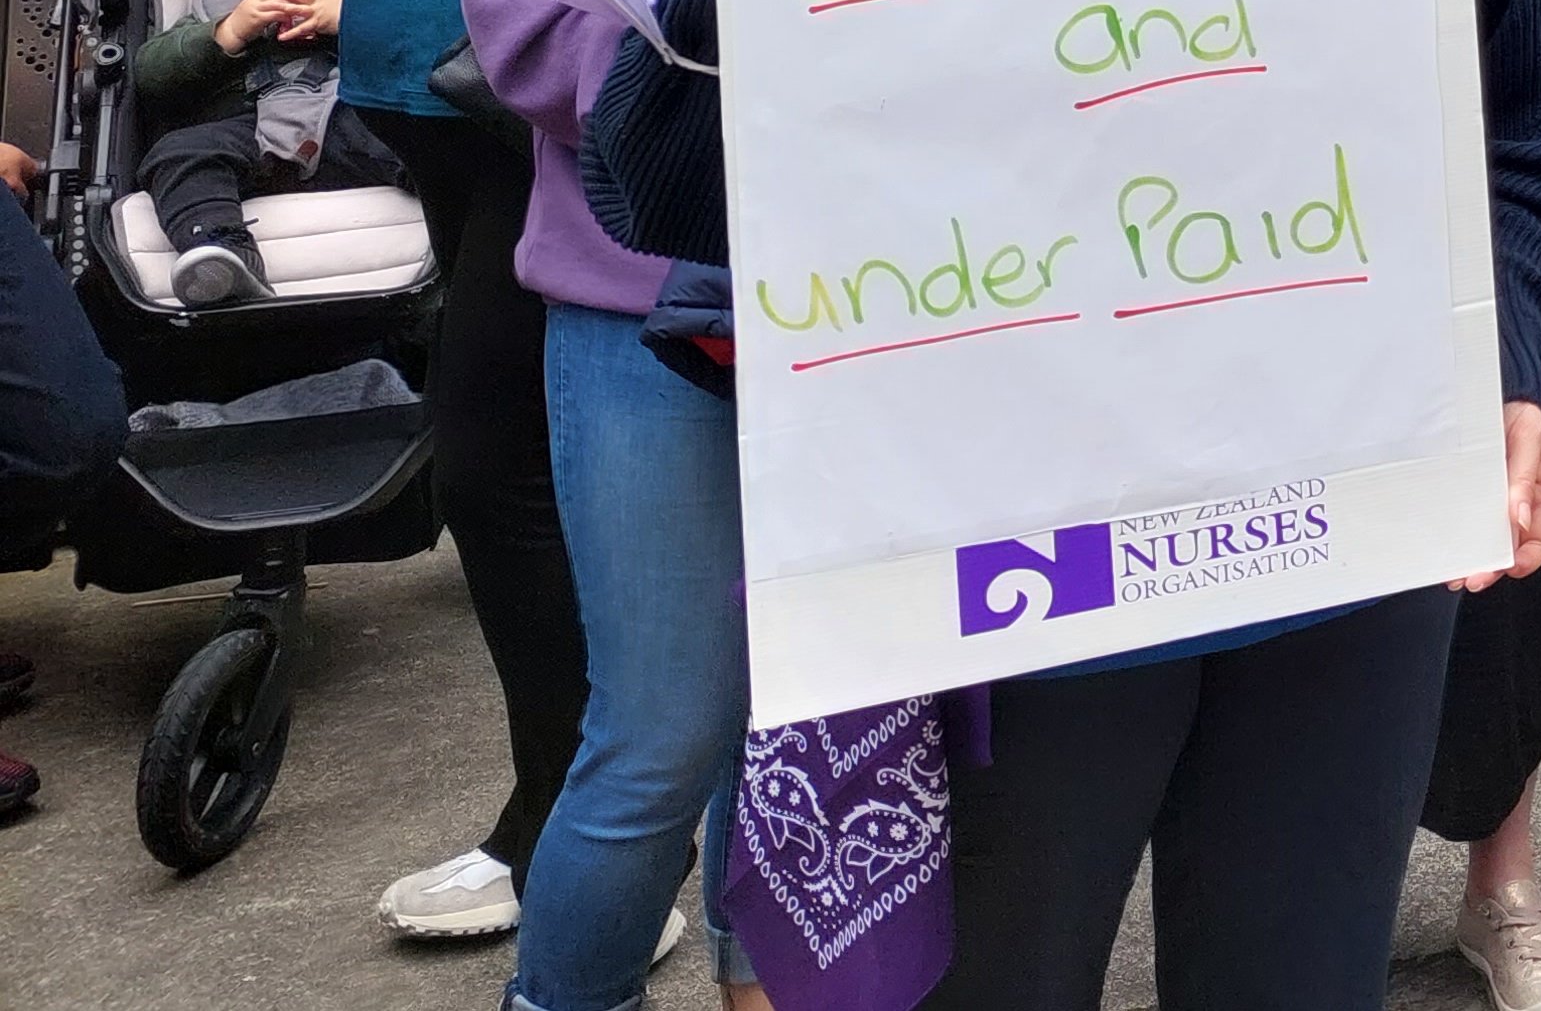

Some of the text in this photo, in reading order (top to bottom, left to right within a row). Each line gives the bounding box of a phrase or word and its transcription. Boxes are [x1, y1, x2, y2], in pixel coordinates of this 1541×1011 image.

[757, 143, 1368, 334] under Paid
[1118, 511, 1183, 537] NEW
[1120, 504, 1330, 579] NURSES
[1121, 542, 1330, 604] ORGANISATION
